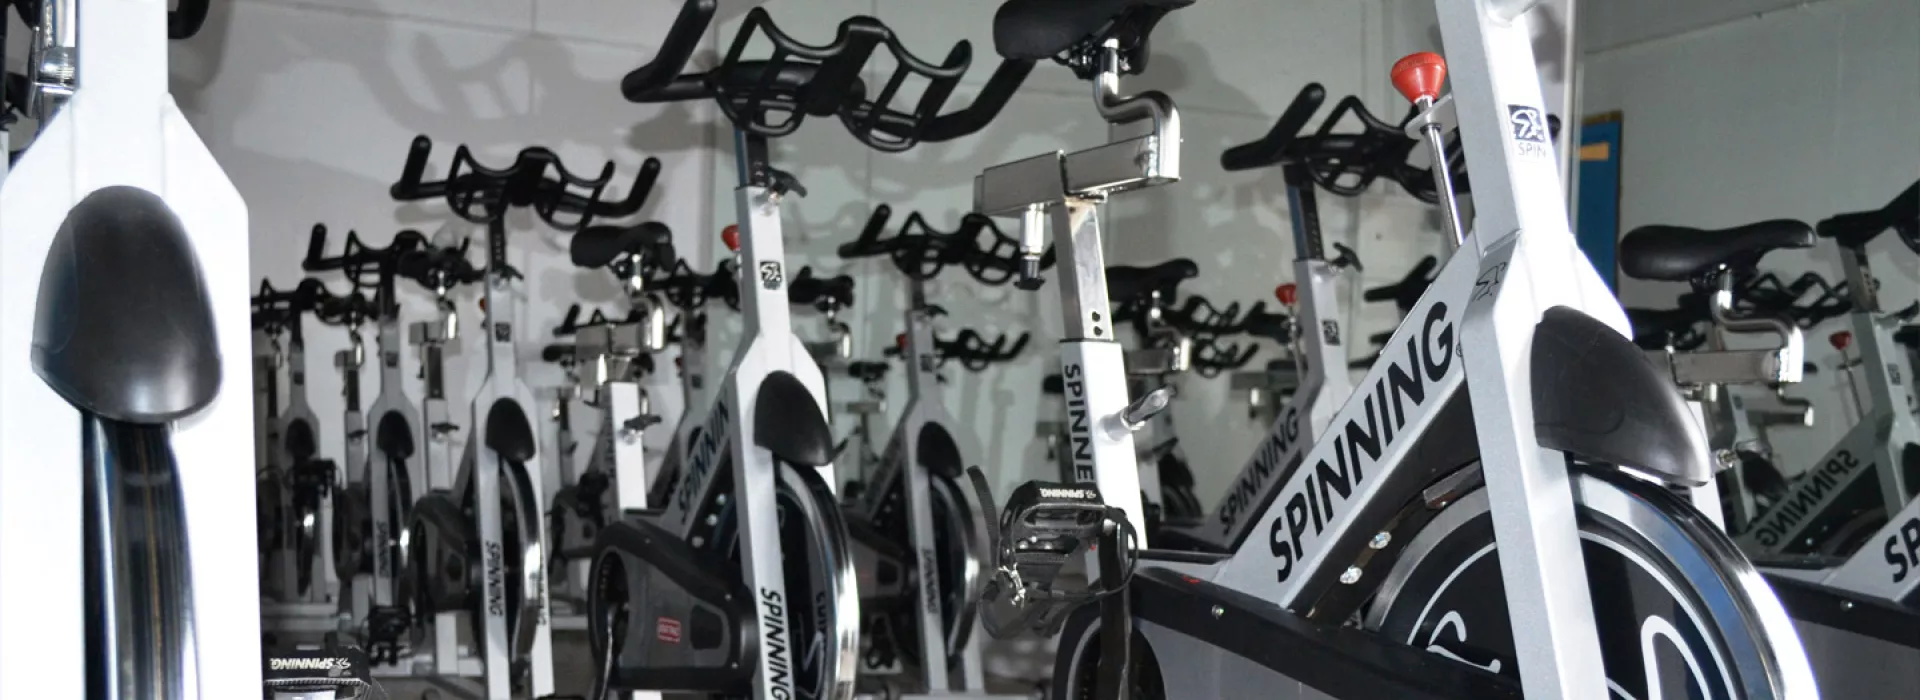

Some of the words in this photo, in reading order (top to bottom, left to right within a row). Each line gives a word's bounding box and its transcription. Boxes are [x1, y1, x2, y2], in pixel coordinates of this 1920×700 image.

[1518, 142, 1546, 157] SPIN
[678, 390, 729, 525] SPINNIN
[1064, 363, 1094, 481] SPINNE
[1220, 406, 1299, 536] SPINNING
[1269, 301, 1453, 583] SPINNING
[485, 541, 503, 617] SPINNING
[761, 586, 791, 700] SPINNING
